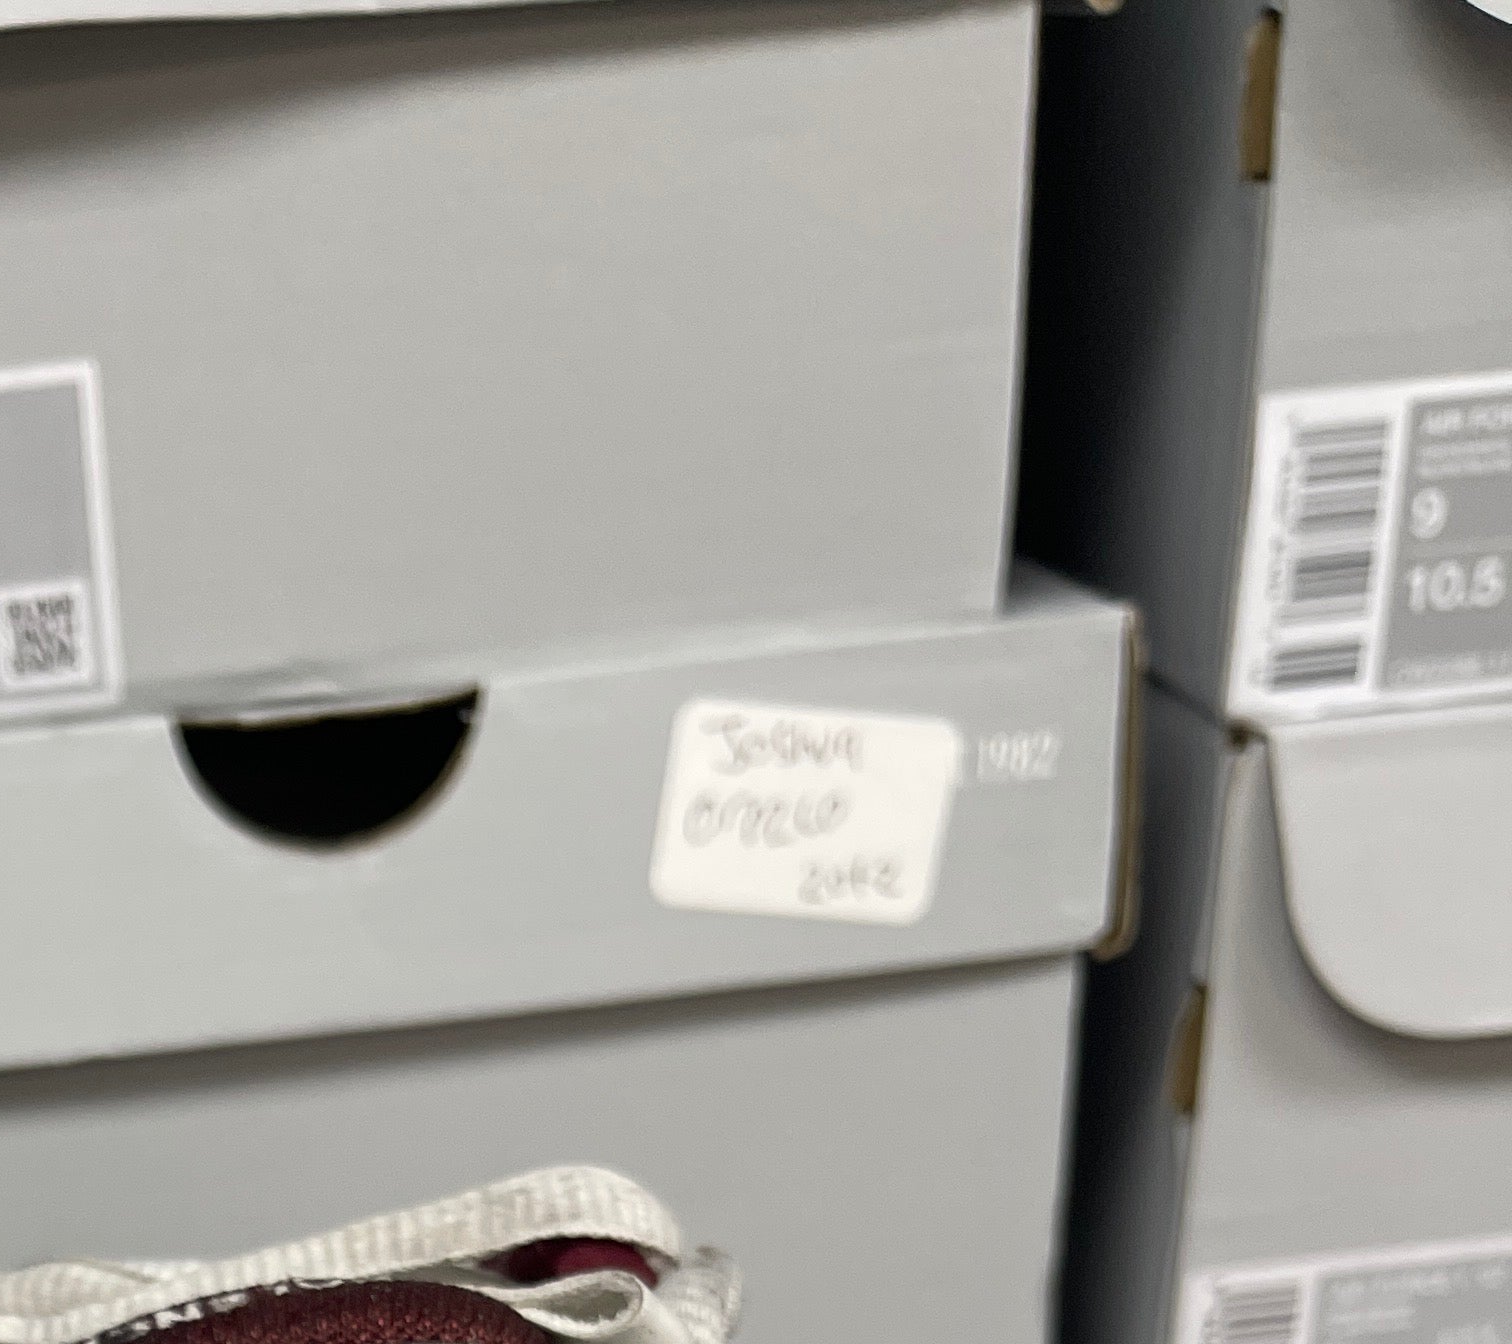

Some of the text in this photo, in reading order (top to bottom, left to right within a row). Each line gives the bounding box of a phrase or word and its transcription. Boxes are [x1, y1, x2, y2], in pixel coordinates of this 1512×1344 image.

[1410, 486, 1448, 541] 9
[1406, 555, 1508, 615] 10.5
[976, 729, 1061, 783] 1982
